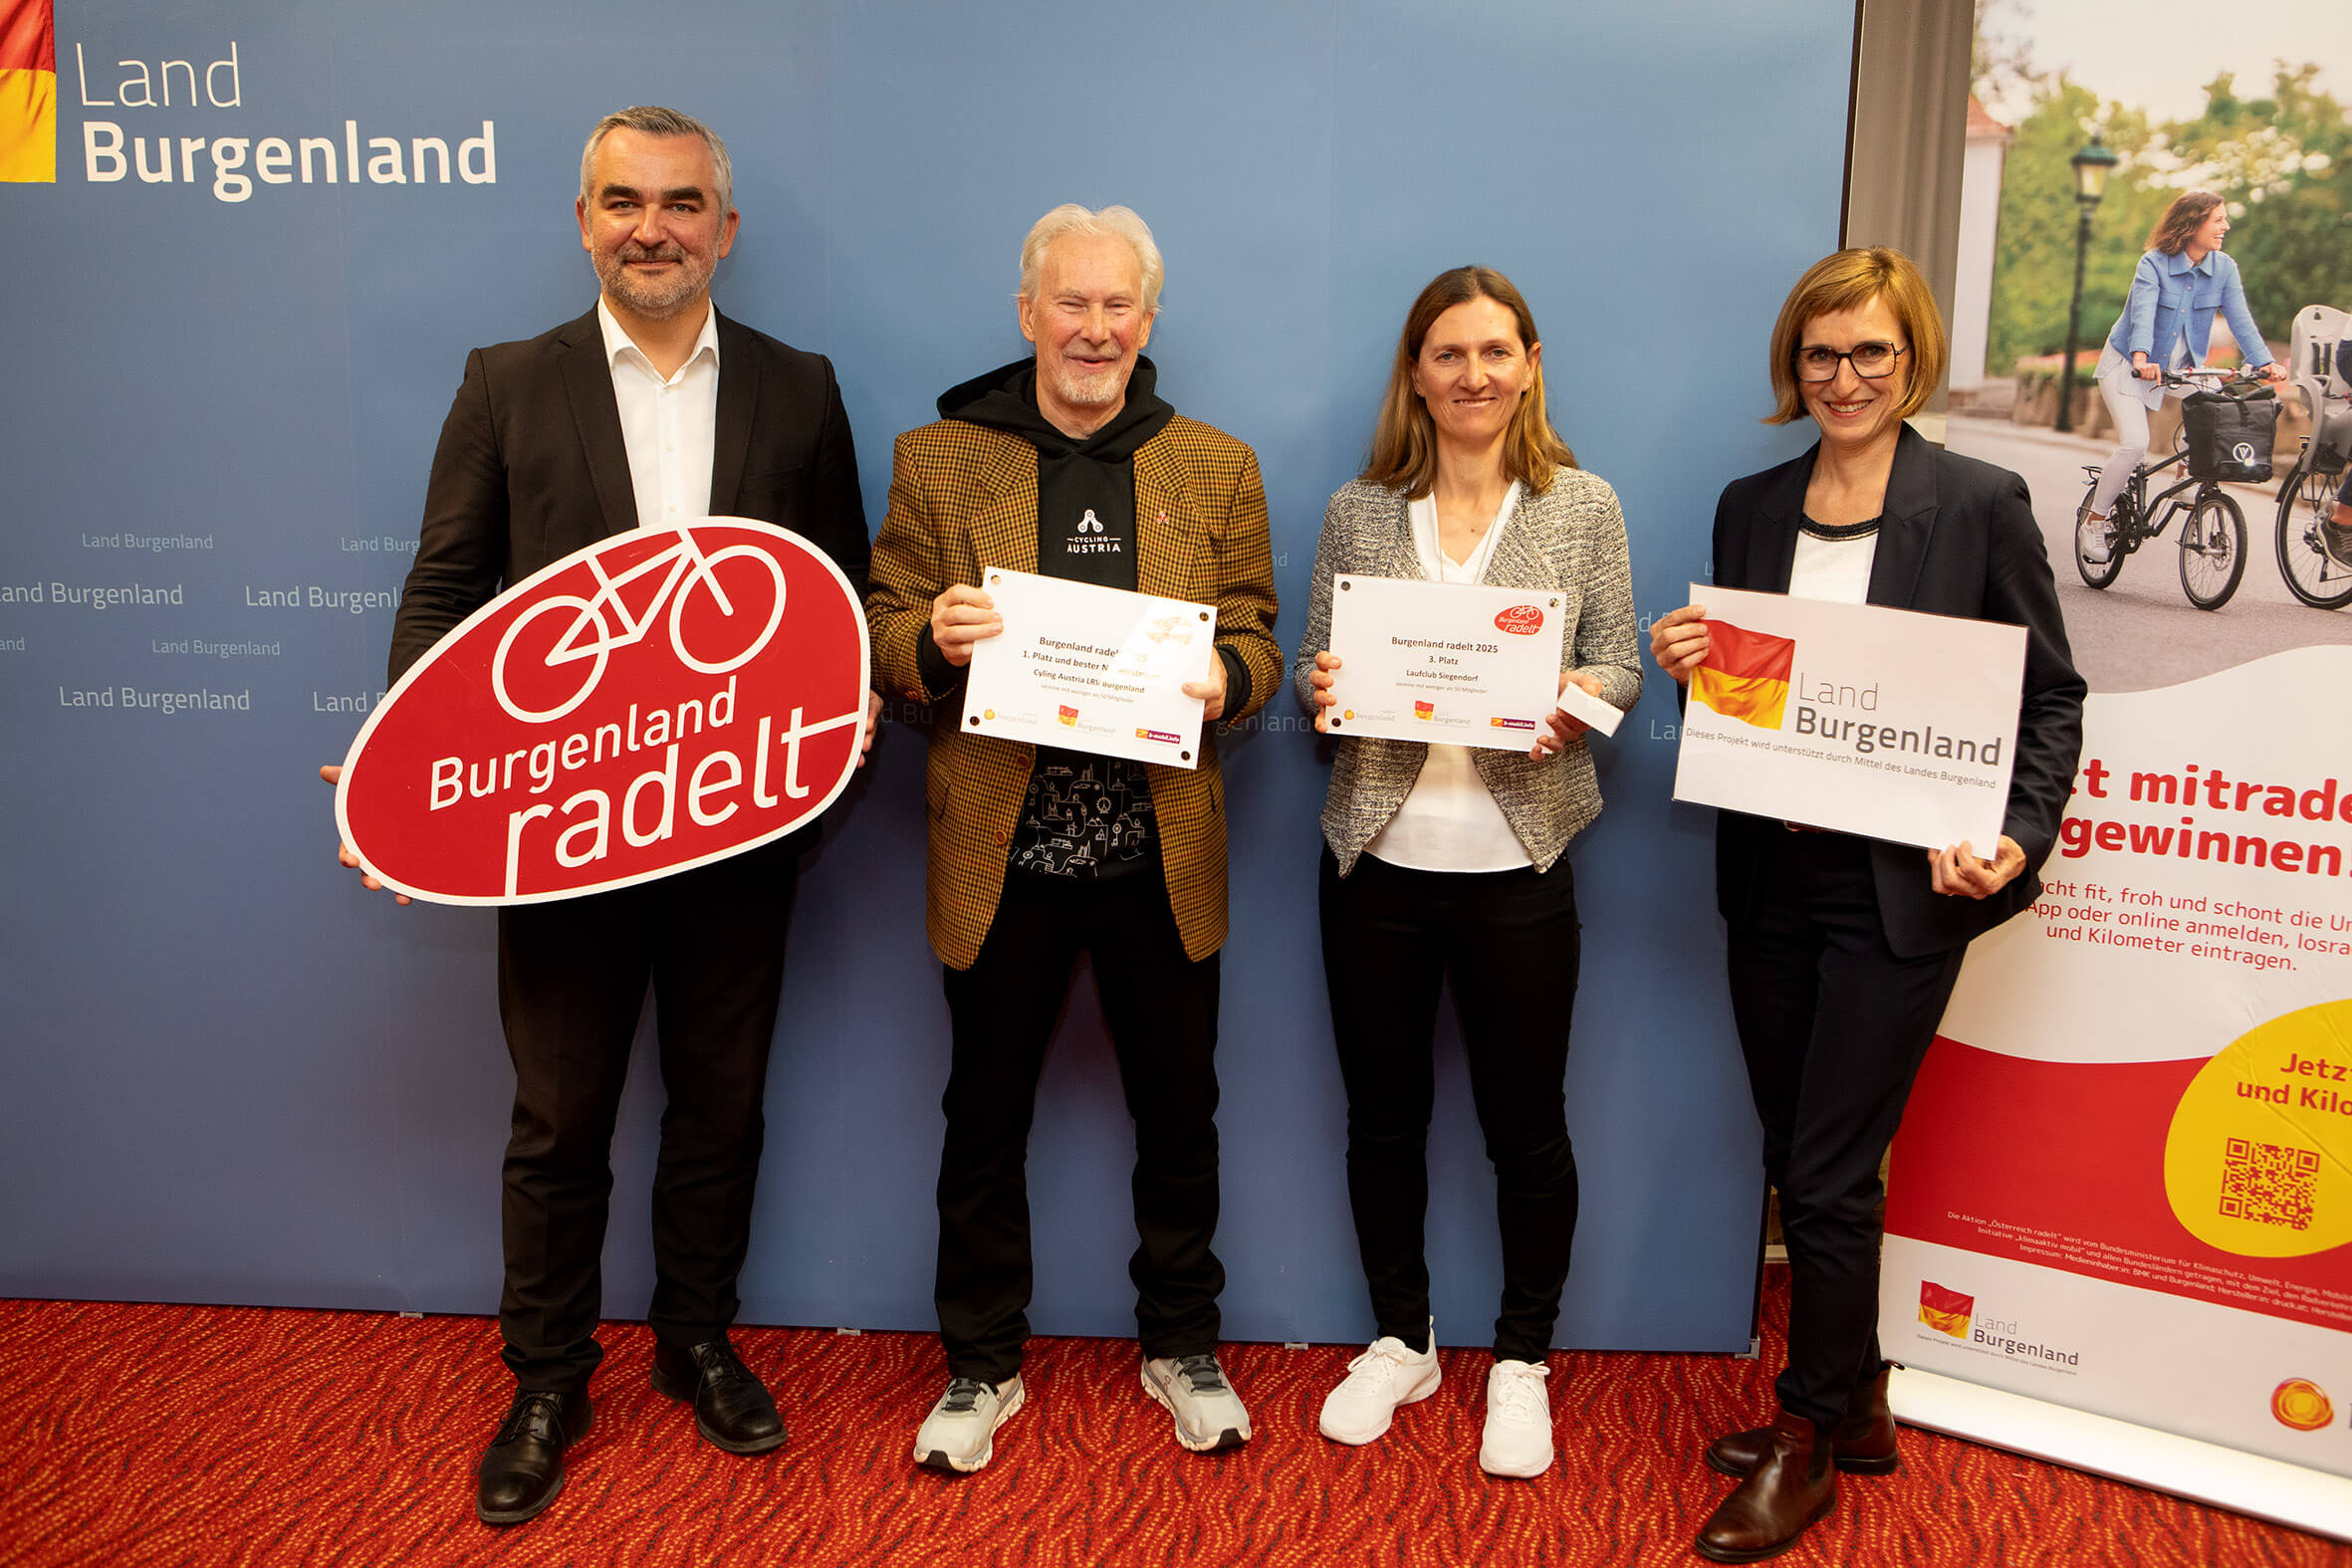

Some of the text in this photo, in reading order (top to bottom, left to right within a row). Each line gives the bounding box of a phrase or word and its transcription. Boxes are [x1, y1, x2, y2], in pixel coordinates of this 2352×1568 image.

[76, 41, 241, 108] Land
[83, 119, 497, 203] Burgenland
[82, 533, 213, 552] Land Burgenland
[342, 537, 420, 555] Land Burg
[1066, 544, 1121, 554] AUSTRIA
[0, 581, 183, 609] and Burgenland
[246, 585, 403, 614] Land Burgenl
[152, 638, 281, 658] Land Burgenland
[1039, 636, 1092, 653] Burgenland
[1391, 637, 1499, 653] Burgenland radelt 2025
[1023, 650, 1031, 659] 1.
[1033, 652, 1053, 663] Platz
[1055, 656, 1071, 666] und
[1073, 659, 1099, 671] bester
[1429, 655, 1459, 665] 3. Platz
[1034, 669, 1057, 680] Cyling
[1058, 672, 1084, 684] Austria
[1406, 669, 1479, 682] Laufclub Siegendorf
[59, 686, 250, 714] Land Burgenland
[313, 691, 367, 713] Land
[1799, 672, 1879, 711] Land
[429, 675, 737, 811] Burgenland
[1795, 706, 2002, 767] Burgenland
[1686, 727, 1997, 789] Dieses Projekt wird unterstützt durch Mittel des Landes Burgenland
[505, 706, 859, 897] radelt
[2060, 816, 2352, 878] gewinnen
[2040, 879, 2077, 897] cht
[2085, 883, 2113, 903] fit,
[2120, 887, 2163, 907] froh
[2169, 896, 2208, 913] und
[2214, 901, 2283, 924] schont
[2290, 910, 2323, 930] die
[2067, 906, 2113, 923] oder
[2118, 910, 2180, 932] online
[2186, 921, 2289, 950] anmelden,
[2297, 933, 2352, 956] losra
[2046, 926, 2298, 972] und Kilometer eintragen.
[2279, 1052, 2352, 1082] Jetz
[2236, 1081, 2352, 1116] und Kilo
[1947, 1211, 1961, 1221] Die
[1962, 1214, 1987, 1226] Aktion
[2063, 1235, 2081, 1245] wird
[2083, 1239, 2099, 1248] vom
[2100, 1241, 2177, 1265] Bundesministerium
[2178, 1258, 2193, 1268] für
[1978, 1226, 2013, 1240] Initiative
[2086, 1248, 2101, 1258] und
[2103, 1252, 2122, 1263] allen
[2123, 1256, 2183, 1277] Bundesländern
[2226, 1278, 2240, 1288] mit
[2242, 1281, 2261, 1292] dem
[2152, 1272, 2168, 1282] und
[1975, 1313, 2017, 1335] Land
[1974, 1329, 2079, 1366] Burgenland
